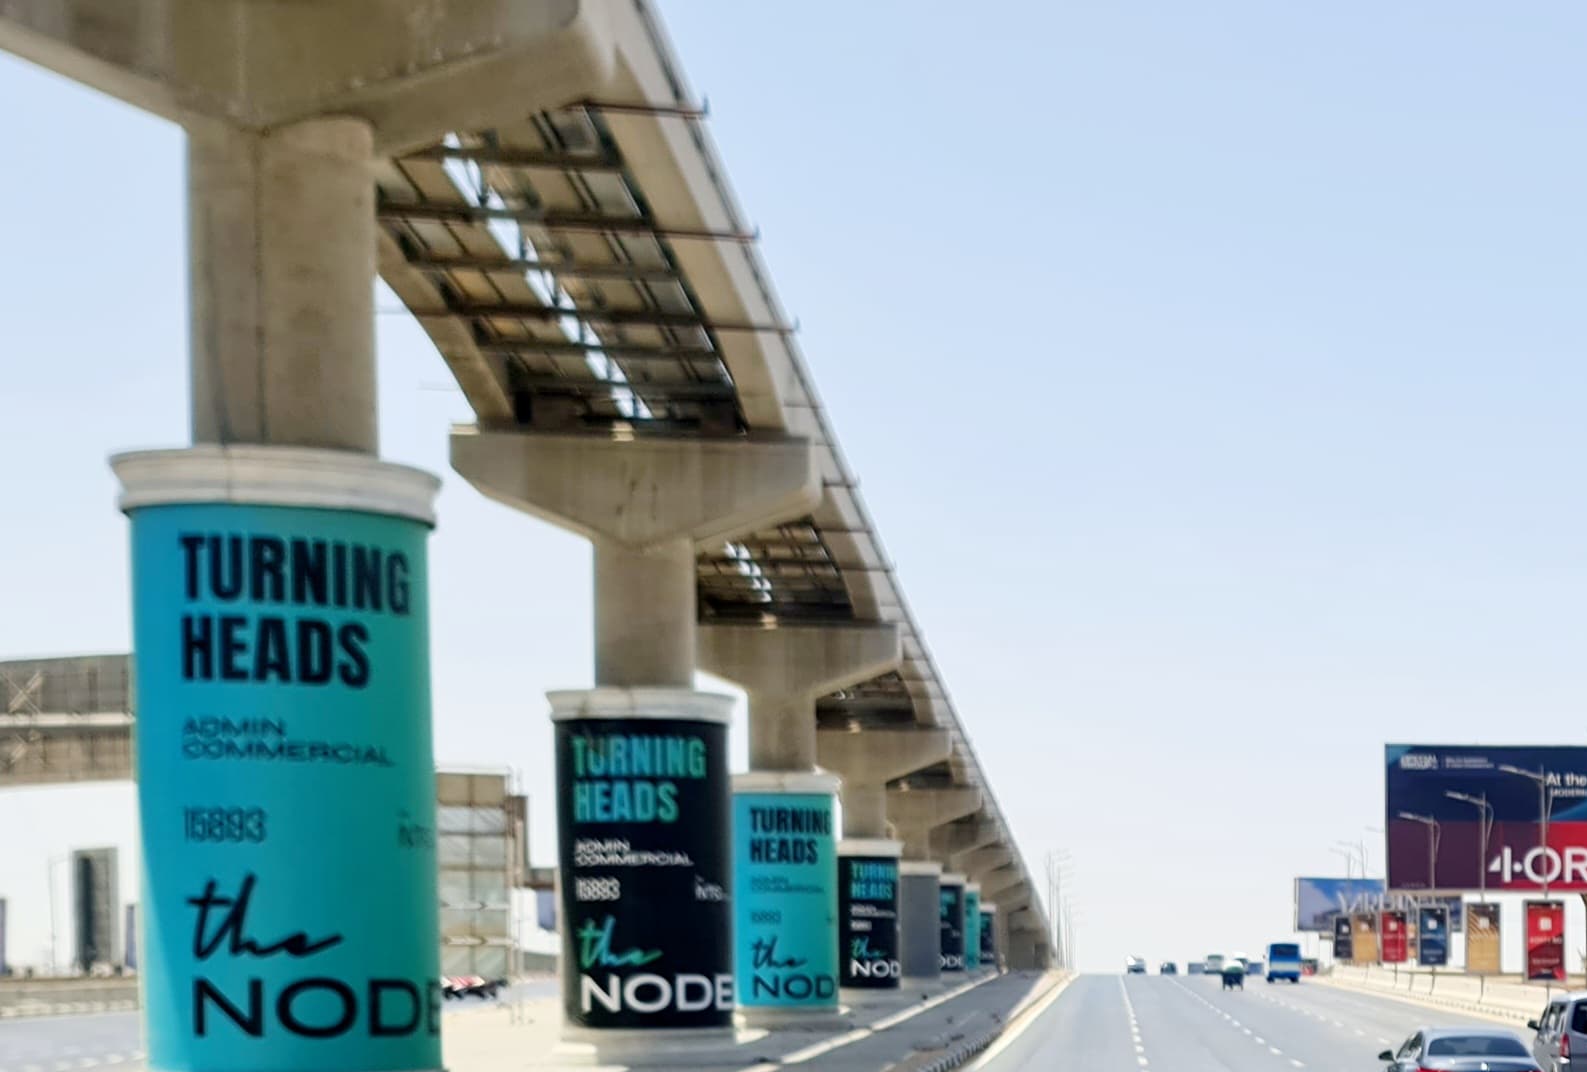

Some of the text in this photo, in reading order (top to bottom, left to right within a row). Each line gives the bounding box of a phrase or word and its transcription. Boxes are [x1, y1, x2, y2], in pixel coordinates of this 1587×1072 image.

[180, 534, 409, 616] TURNING
[181, 615, 370, 689] HEADS
[183, 716, 285, 737] ADMIN
[183, 738, 396, 767] COMMERCIAL
[572, 735, 707, 779] TURNING
[1565, 772, 1587, 787] the
[574, 780, 680, 823] HEADS
[184, 806, 267, 843] 15893
[750, 837, 818, 865] HEADS
[187, 874, 343, 960] the
[577, 915, 663, 969] the
[752, 936, 807, 969] the
[753, 974, 835, 1000] NOD
[851, 959, 901, 978] NOD
[581, 973, 735, 1014] NODE
